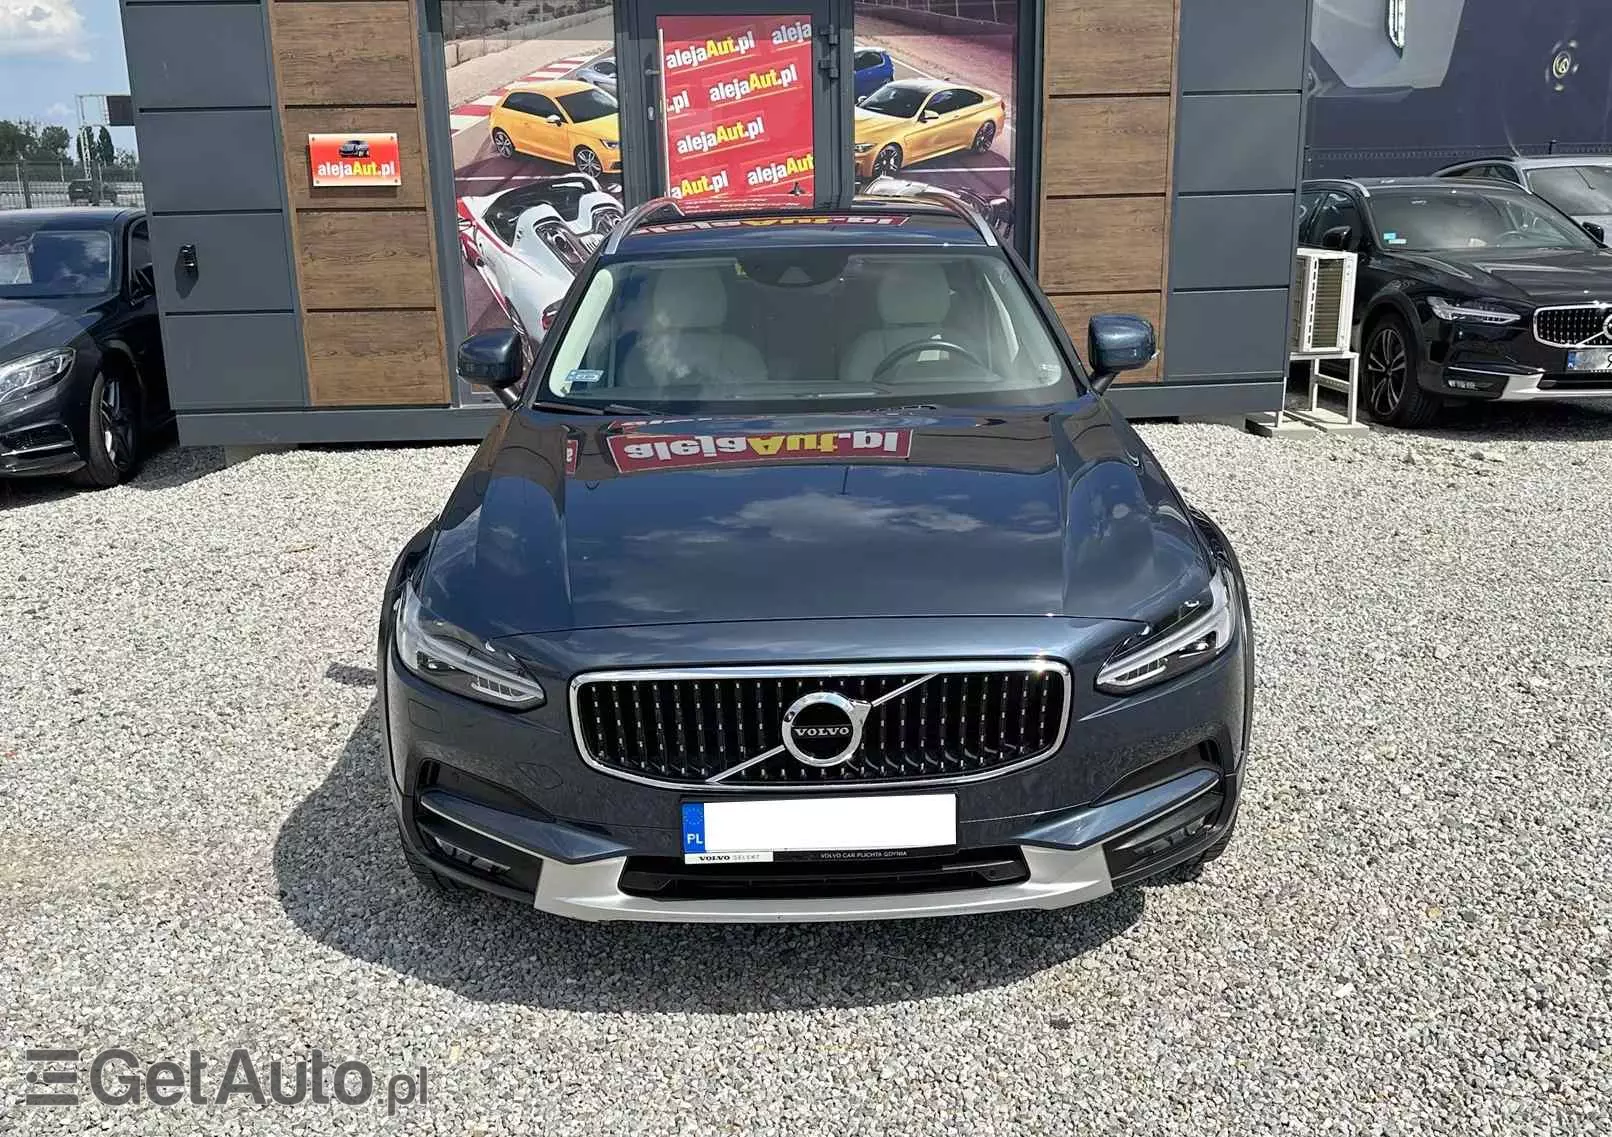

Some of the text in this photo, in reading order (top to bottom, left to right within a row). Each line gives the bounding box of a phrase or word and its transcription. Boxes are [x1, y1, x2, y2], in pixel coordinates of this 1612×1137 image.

[666, 31, 755, 69] alejaAut.pl
[709, 64, 798, 102] alejaAut.pl
[676, 117, 765, 154] alejaAut.pl
[318, 161, 395, 178] alejaAut.pl
[794, 727, 849, 736] VOLVO
[687, 833, 703, 845] PL
